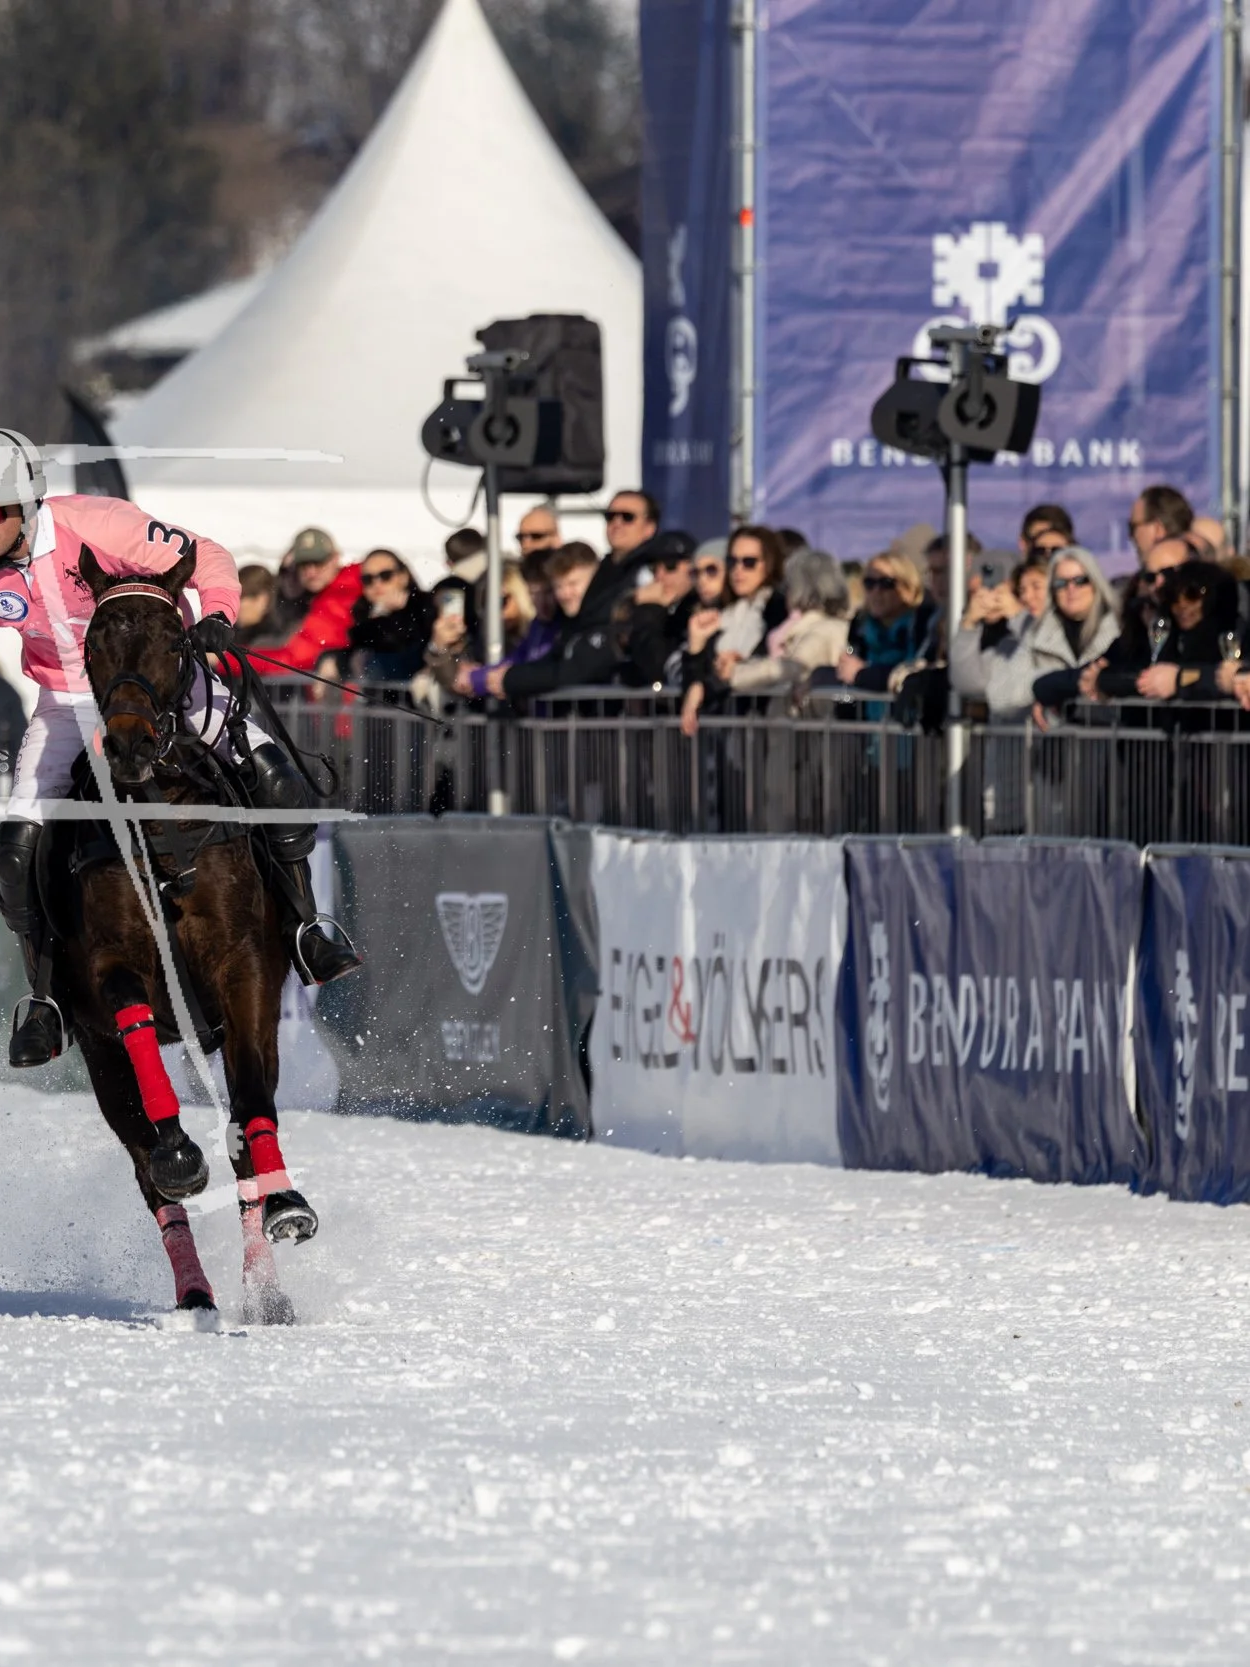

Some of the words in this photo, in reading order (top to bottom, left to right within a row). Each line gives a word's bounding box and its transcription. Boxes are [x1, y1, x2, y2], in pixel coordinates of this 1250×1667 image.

[831, 438, 1019, 467] BENA
[1033, 438, 1140, 467] BANK
[147, 520, 192, 558] 3
